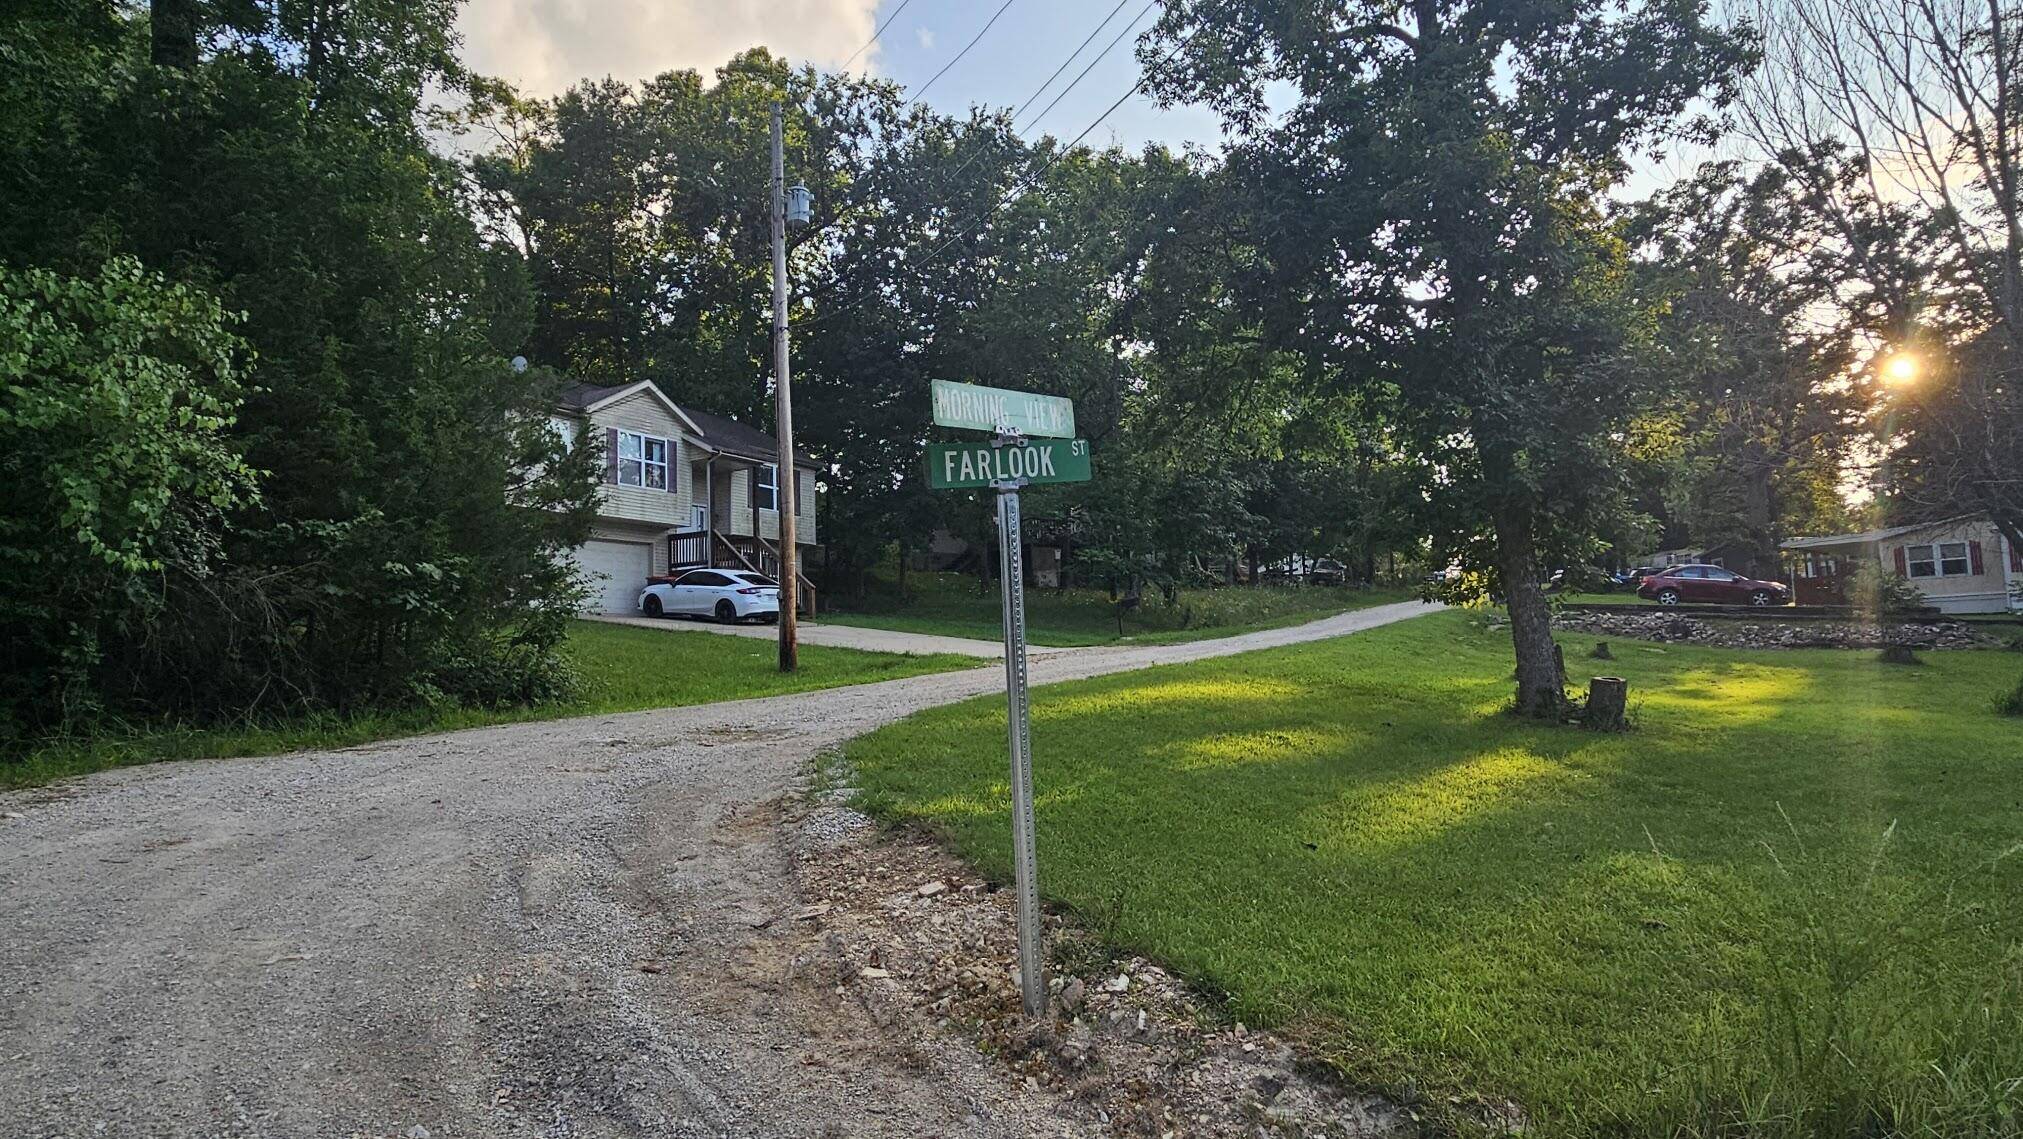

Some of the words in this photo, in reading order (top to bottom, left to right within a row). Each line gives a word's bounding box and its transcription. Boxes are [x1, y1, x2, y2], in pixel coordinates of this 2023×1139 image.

[936, 387, 1010, 425] MORNING
[1024, 400, 1063, 431] VIEW
[944, 446, 1056, 482] FARLOOK
[1071, 440, 1085, 456] ST
